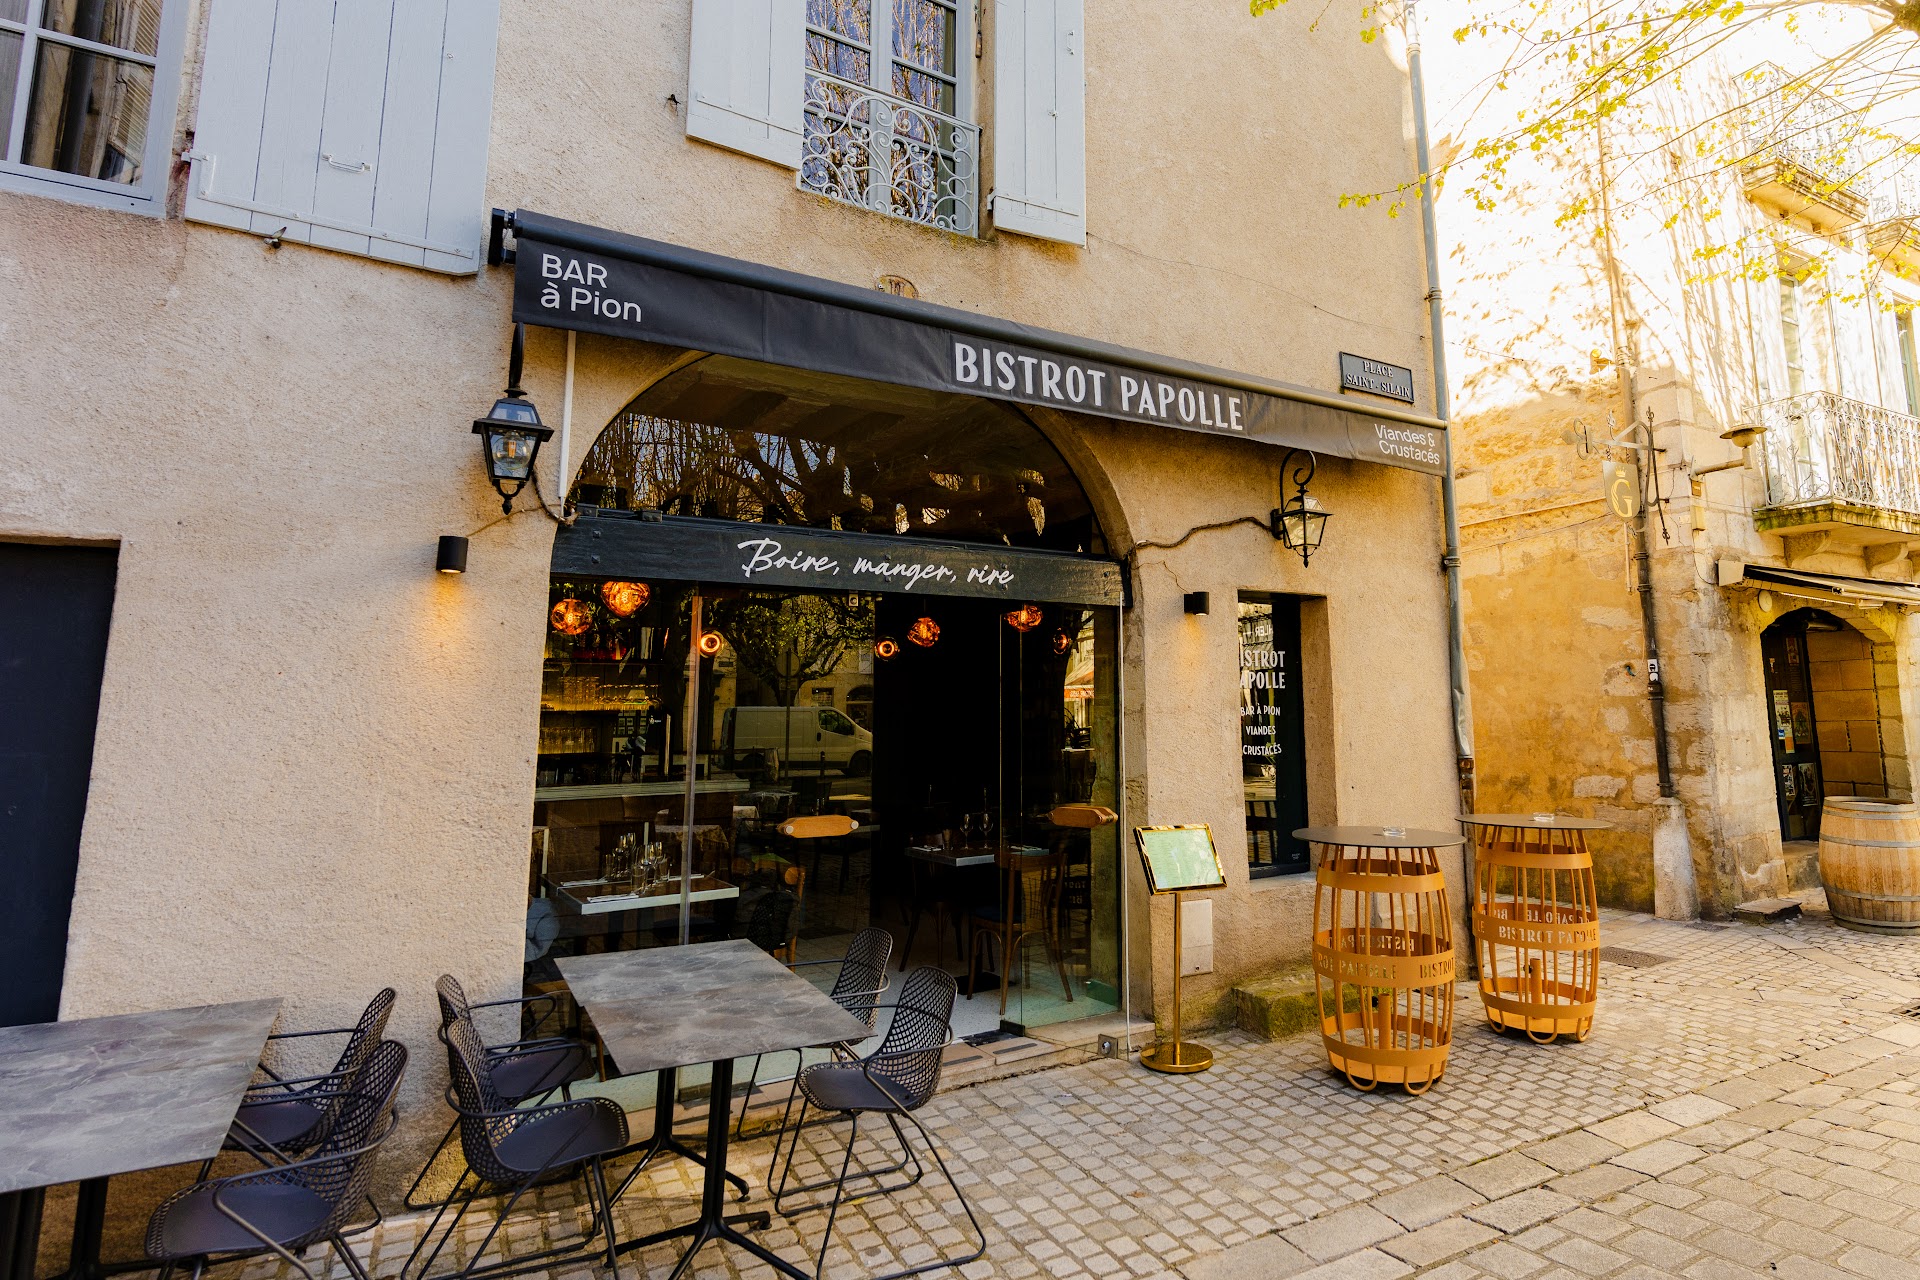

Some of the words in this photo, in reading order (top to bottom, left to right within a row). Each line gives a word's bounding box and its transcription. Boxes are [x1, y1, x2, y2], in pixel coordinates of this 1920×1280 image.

[541, 253, 607, 289] BAR
[540, 281, 560, 309] à
[570, 286, 642, 323] Pion
[1363, 360, 1394, 378] PLACE
[954, 342, 1106, 407] BISTROT
[1120, 375, 1243, 431] PAPOLLE
[1374, 423, 1427, 446] Viandes
[1427, 432, 1436, 448] &
[1378, 440, 1440, 465] Crustacés
[737, 537, 841, 578] Boire,
[852, 554, 957, 590] manger,
[966, 564, 1014, 586] rire
[1240, 650, 1286, 668] ISTROT
[1239, 671, 1286, 689] APOLLE
[1240, 705, 1255, 717] BAR
[1263, 705, 1281, 716] PION
[1245, 725, 1276, 736] VIANDES
[1242, 742, 1282, 756] CRUSTACÉS
[1498, 925, 1554, 944] BISTROT
[1419, 956, 1455, 979] BISTROT
